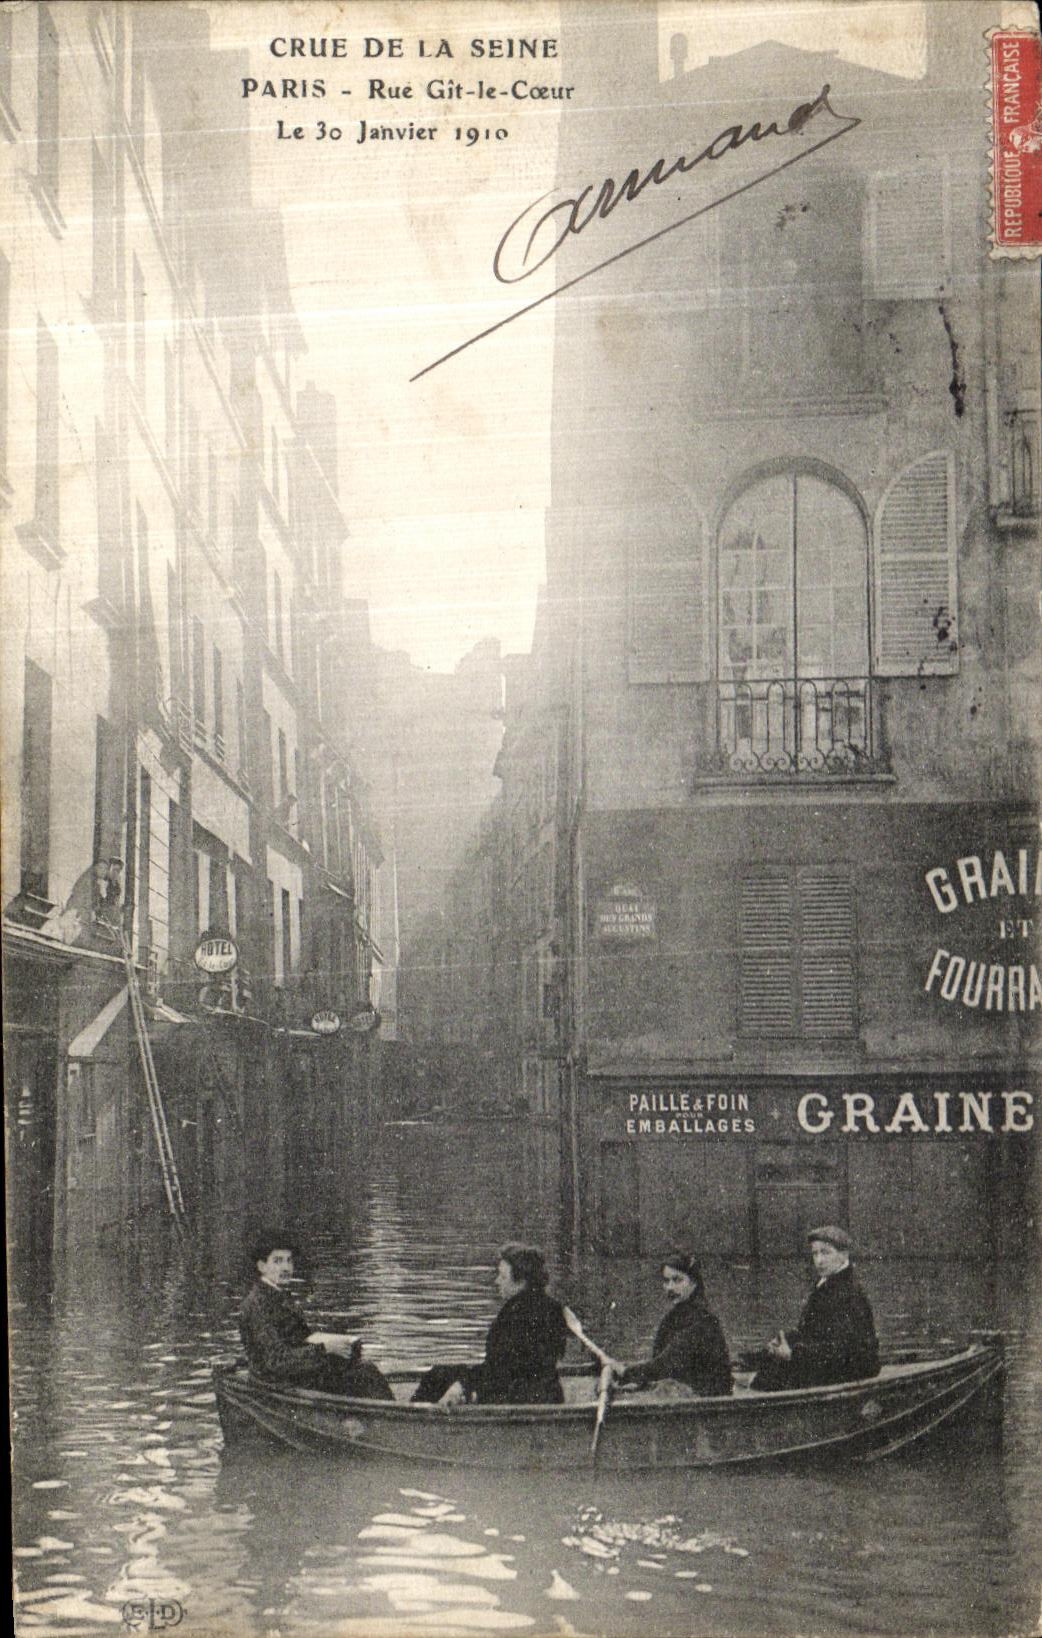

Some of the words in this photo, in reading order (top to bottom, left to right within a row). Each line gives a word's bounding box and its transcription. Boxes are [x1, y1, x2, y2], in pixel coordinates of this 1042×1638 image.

[629, 1093, 690, 1112] PAILLE
[692, 1098, 704, 1111] &
[706, 1093, 749, 1111] FOIN
[797, 1090, 1035, 1134] GRAINE
[626, 1118, 755, 1133] EMBALLAGES
